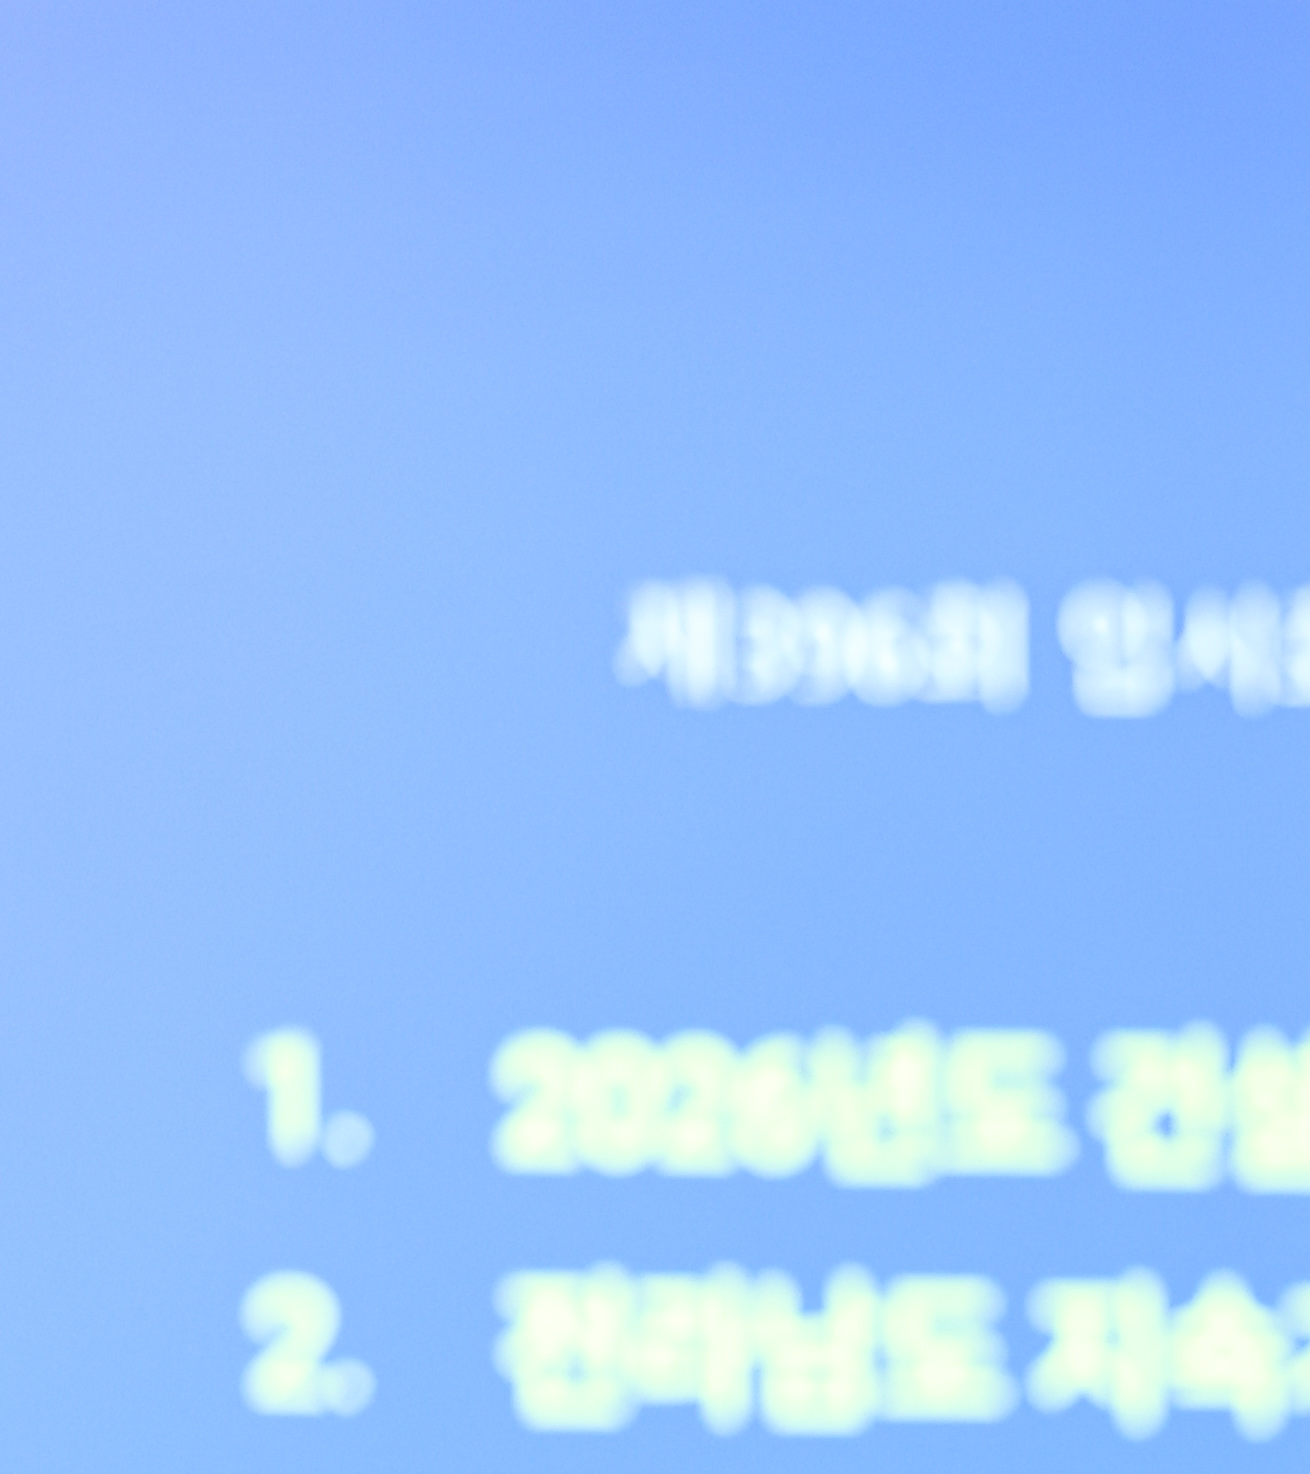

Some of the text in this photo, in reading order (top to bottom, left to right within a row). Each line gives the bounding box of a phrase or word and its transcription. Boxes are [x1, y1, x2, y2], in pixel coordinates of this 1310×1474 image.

[247, 1029, 370, 1163] 1.
[491, 1023, 1073, 1186] 2026년도
[242, 1272, 372, 1413] 2.
[496, 1264, 1013, 1433] 전라남도
